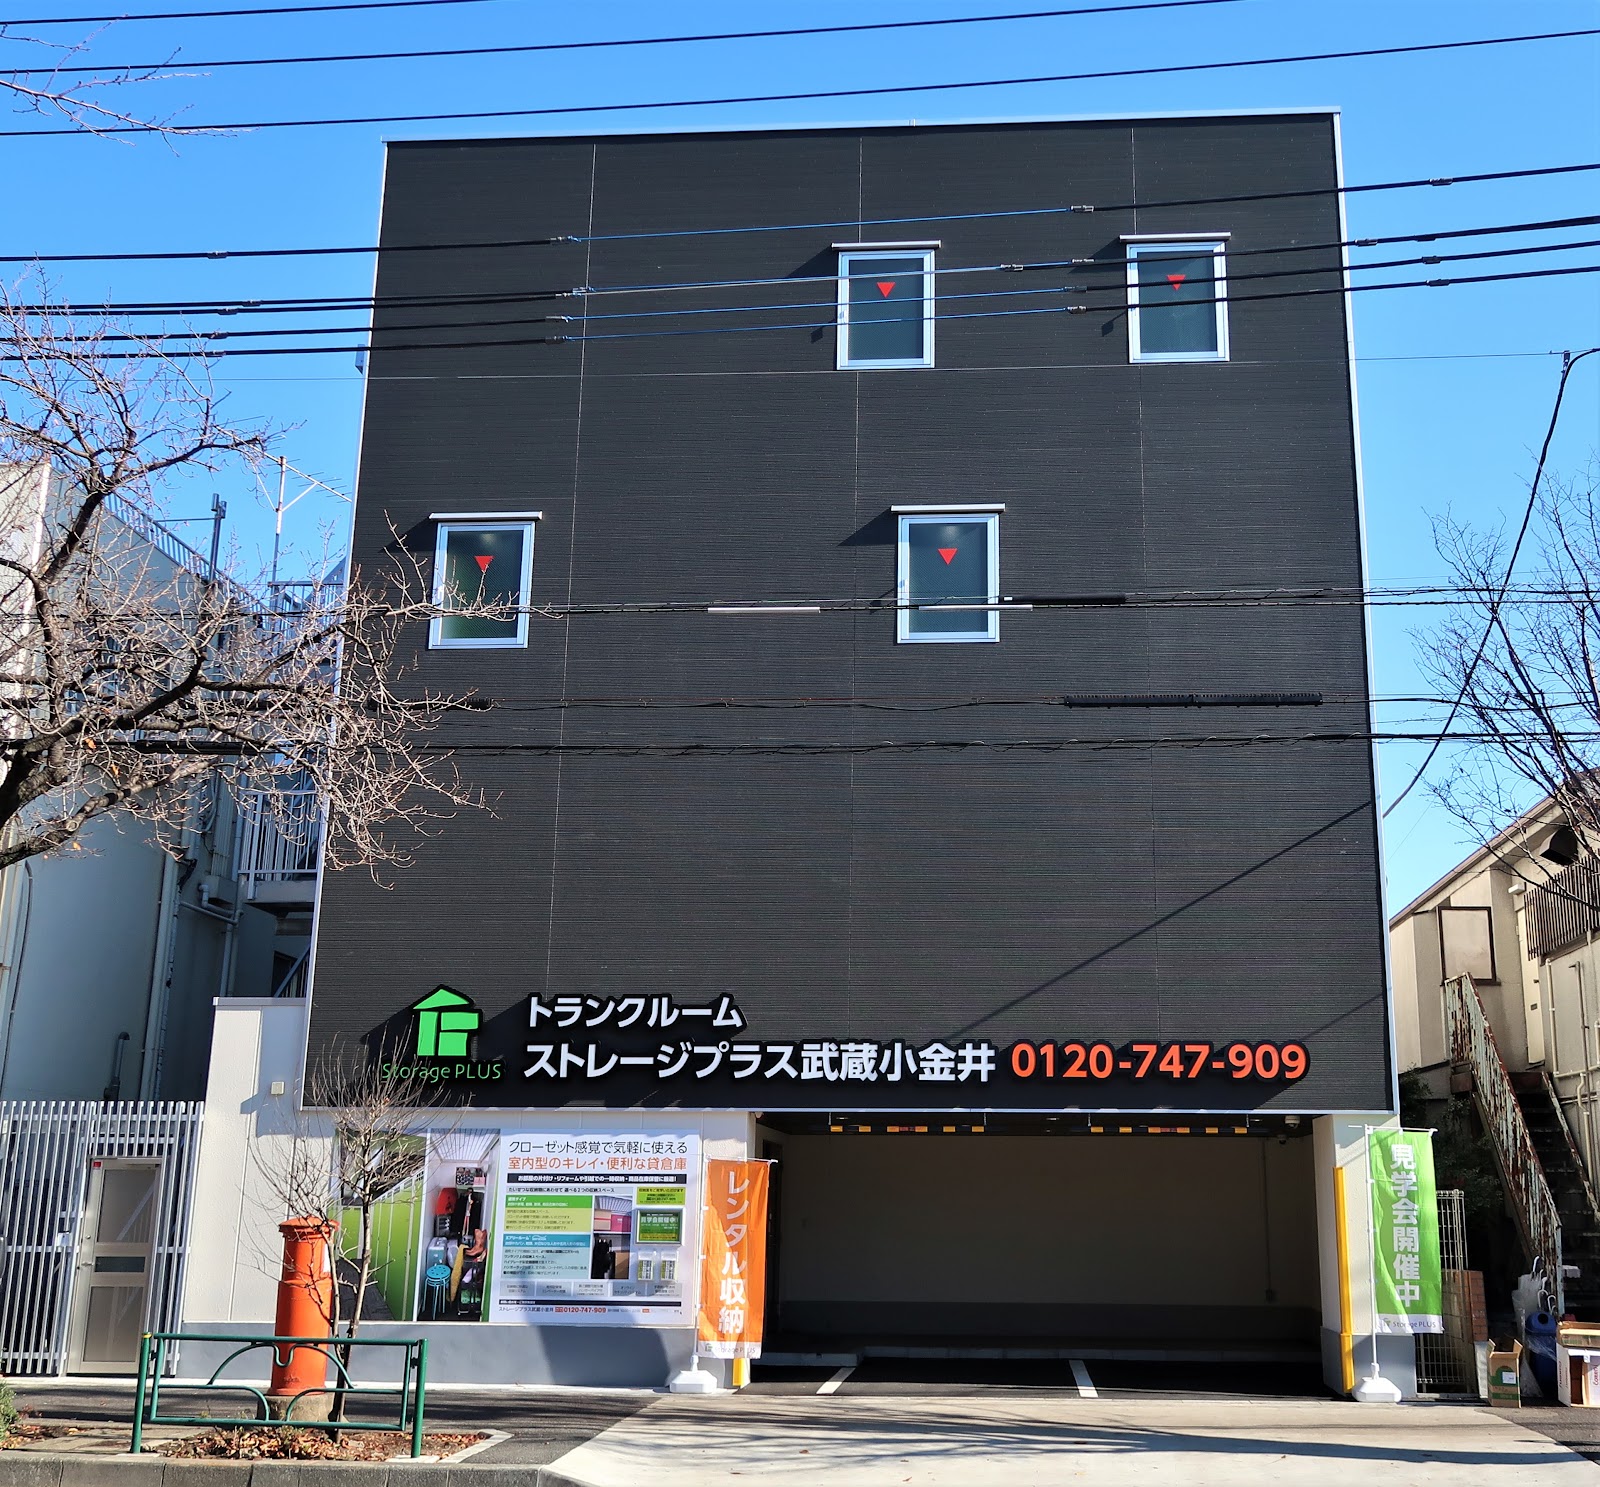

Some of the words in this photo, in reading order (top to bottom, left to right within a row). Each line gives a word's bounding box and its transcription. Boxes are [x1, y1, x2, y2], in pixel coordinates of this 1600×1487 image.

[529, 996, 743, 1028] トランクルーム
[455, 1063, 501, 1079] PLUS
[523, 1041, 996, 1082] ストレージプラス武蔵小金井
[1011, 1043, 1307, 1080] 0120-747-909
[509, 1141, 688, 1155] クローゼット感覚で気軽に使える
[508, 1157, 687, 1171] 室内型のキレイ・便利な貸倉庫
[1390, 1144, 1420, 1308] 見学会開催中
[718, 1171, 750, 1334] レンタル収納
[1393, 1320, 1418, 1329] Storge
